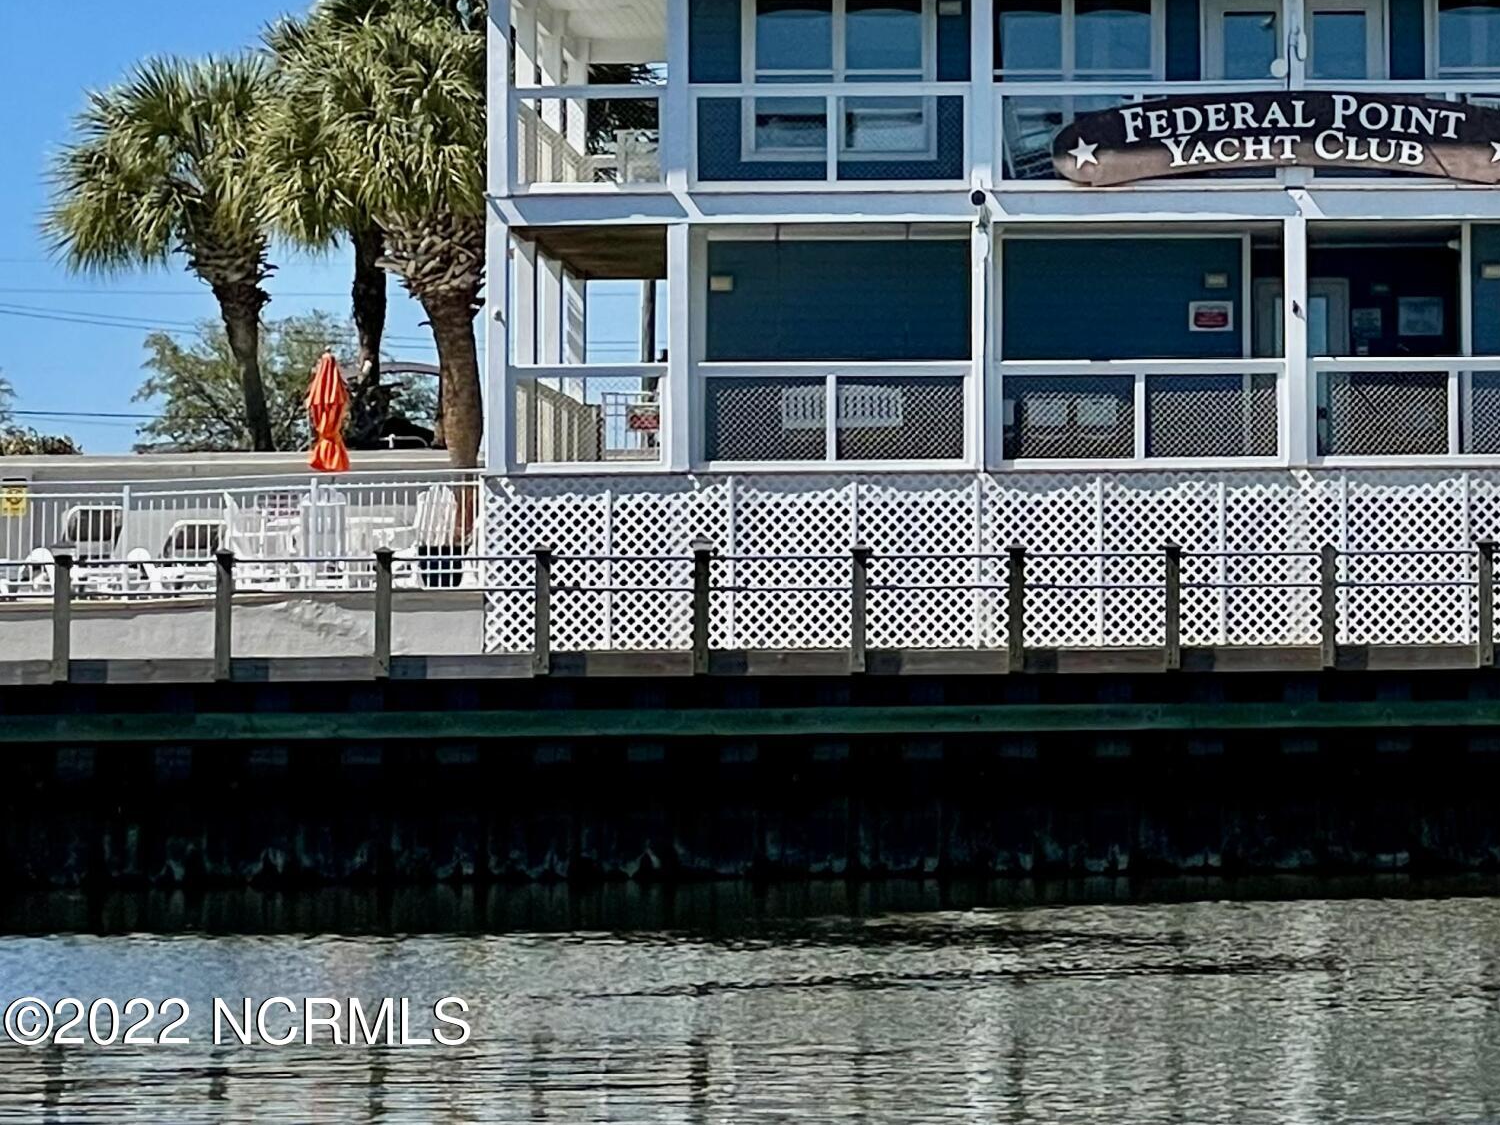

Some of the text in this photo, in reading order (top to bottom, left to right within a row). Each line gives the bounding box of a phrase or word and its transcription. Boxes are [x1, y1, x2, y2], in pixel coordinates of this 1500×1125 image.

[1119, 93, 1467, 143] FEDERAL POINT
[1160, 130, 1425, 167] YACHT CLUB
